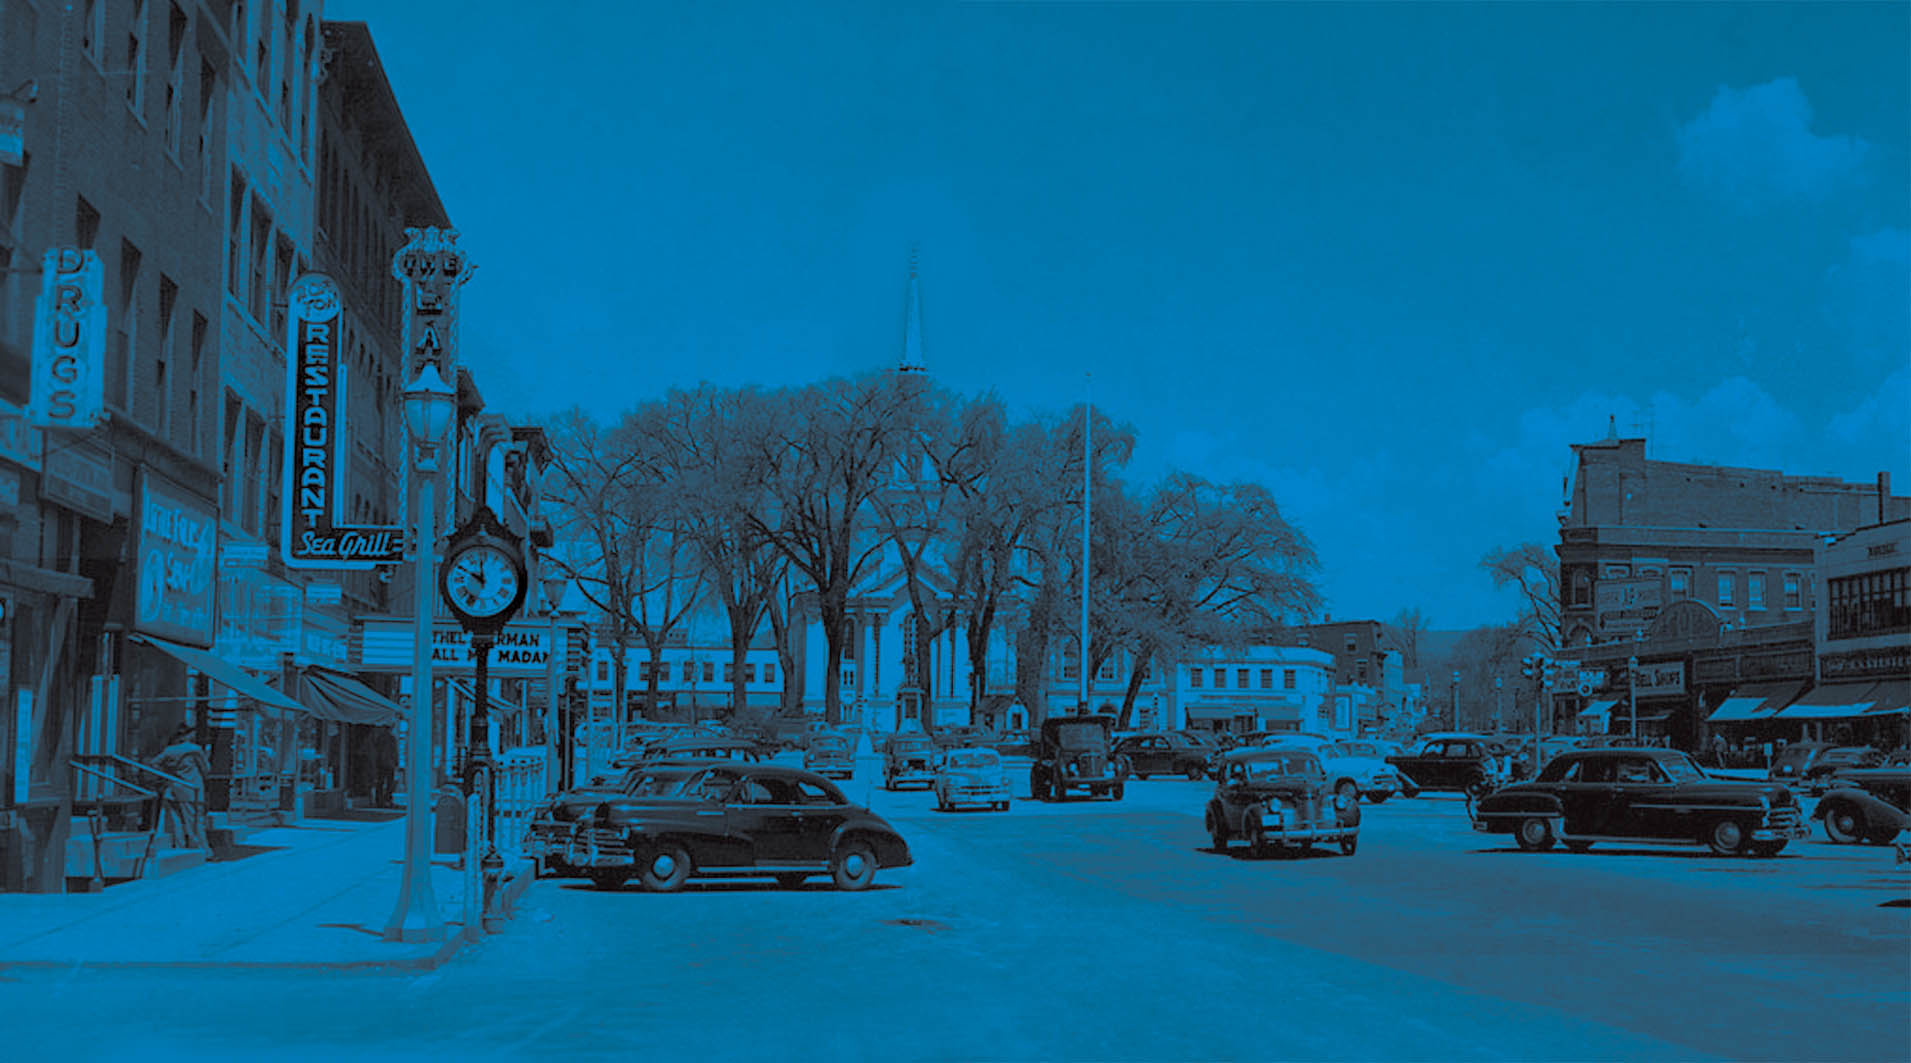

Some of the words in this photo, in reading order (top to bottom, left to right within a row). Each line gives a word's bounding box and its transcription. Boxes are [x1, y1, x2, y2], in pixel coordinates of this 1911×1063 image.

[48, 247, 84, 419] DRUGS
[301, 324, 331, 528] RESTAURANT
[297, 531, 336, 555] Sea
[339, 532, 390, 561] Grill
[432, 631, 466, 644] THEL
[496, 631, 540, 648] RMAN
